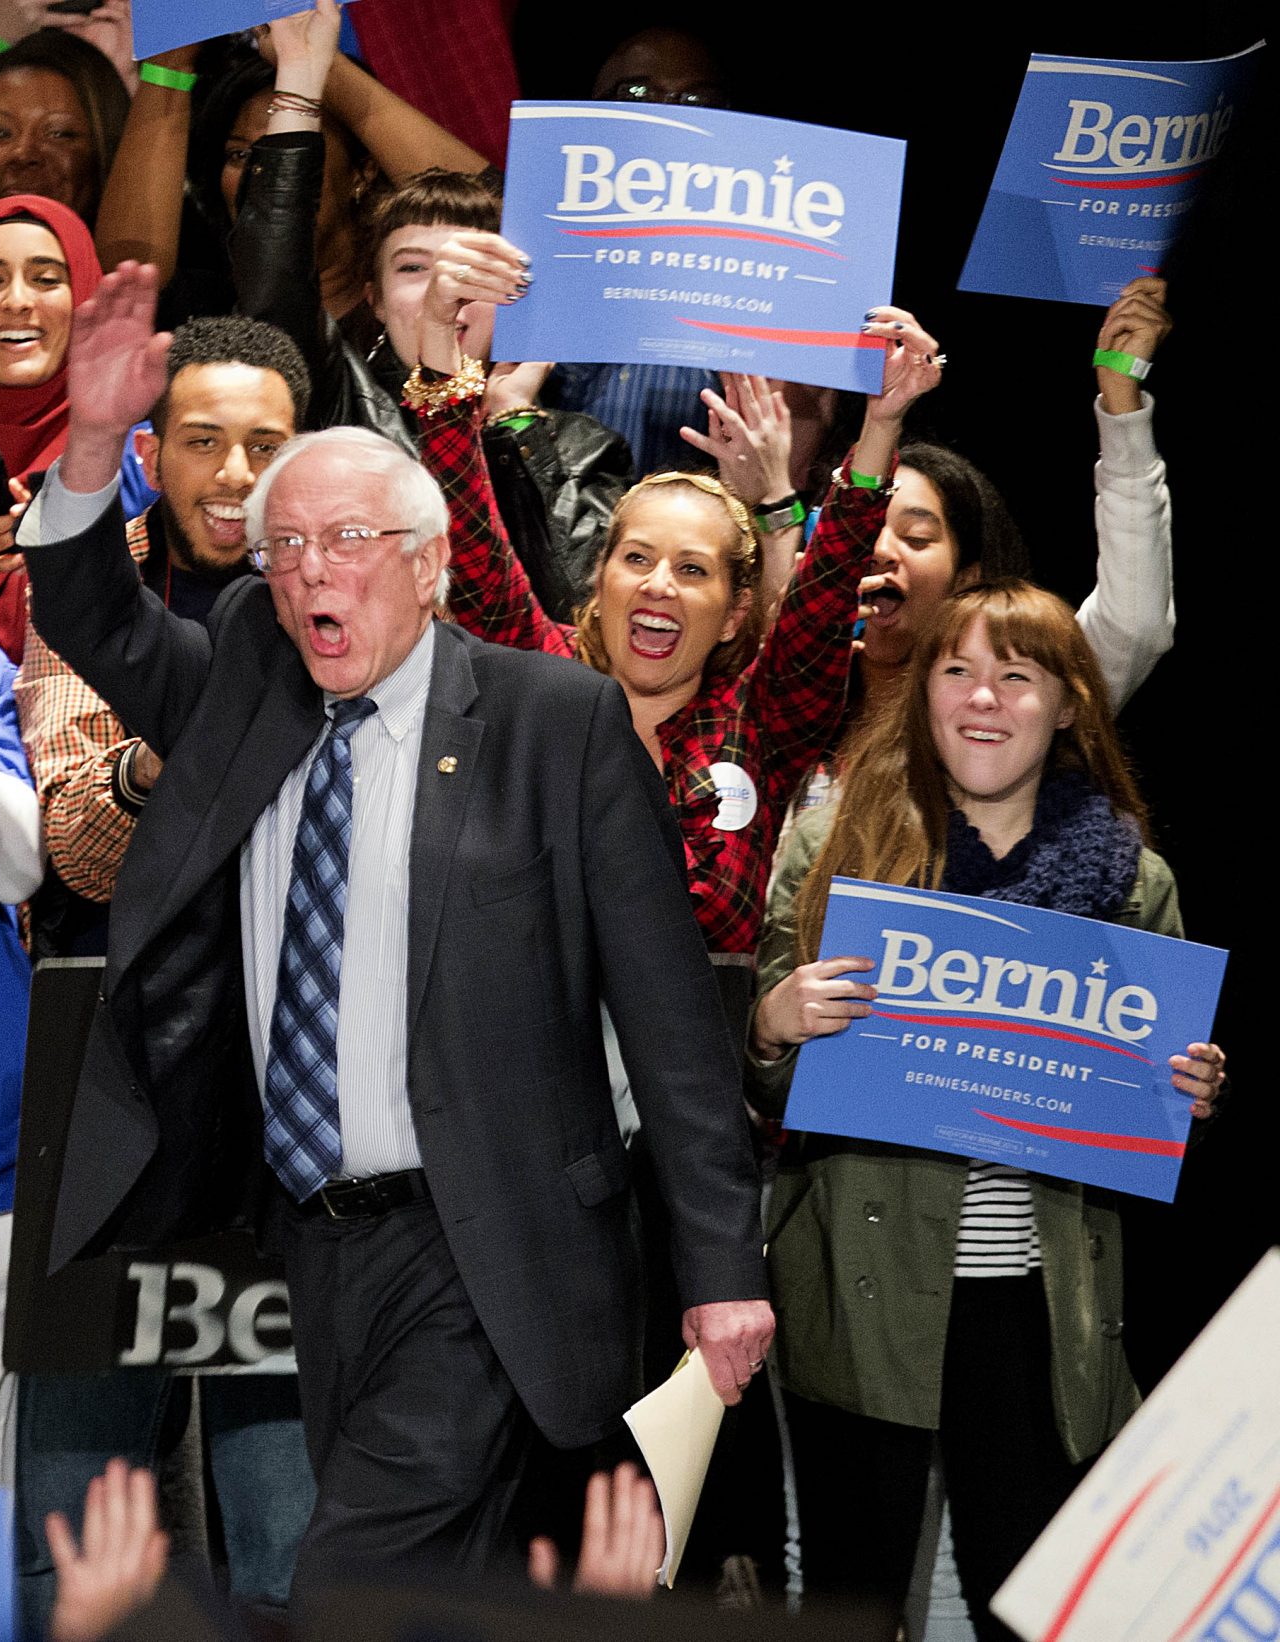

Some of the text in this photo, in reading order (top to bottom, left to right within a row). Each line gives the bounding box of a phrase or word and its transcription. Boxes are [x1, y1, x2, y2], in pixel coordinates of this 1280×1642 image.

[556, 144, 845, 239] Bernie
[1078, 199, 1119, 215] FOR
[594, 248, 790, 282] FOR PRESIDENT
[602, 286, 773, 314] BERNIESANDERS.COM
[874, 928, 1158, 1041] Bernie
[901, 1033, 1093, 1083] FOR PRESIDENT
[904, 1070, 1073, 1114] BERNIESANDERS.COM
